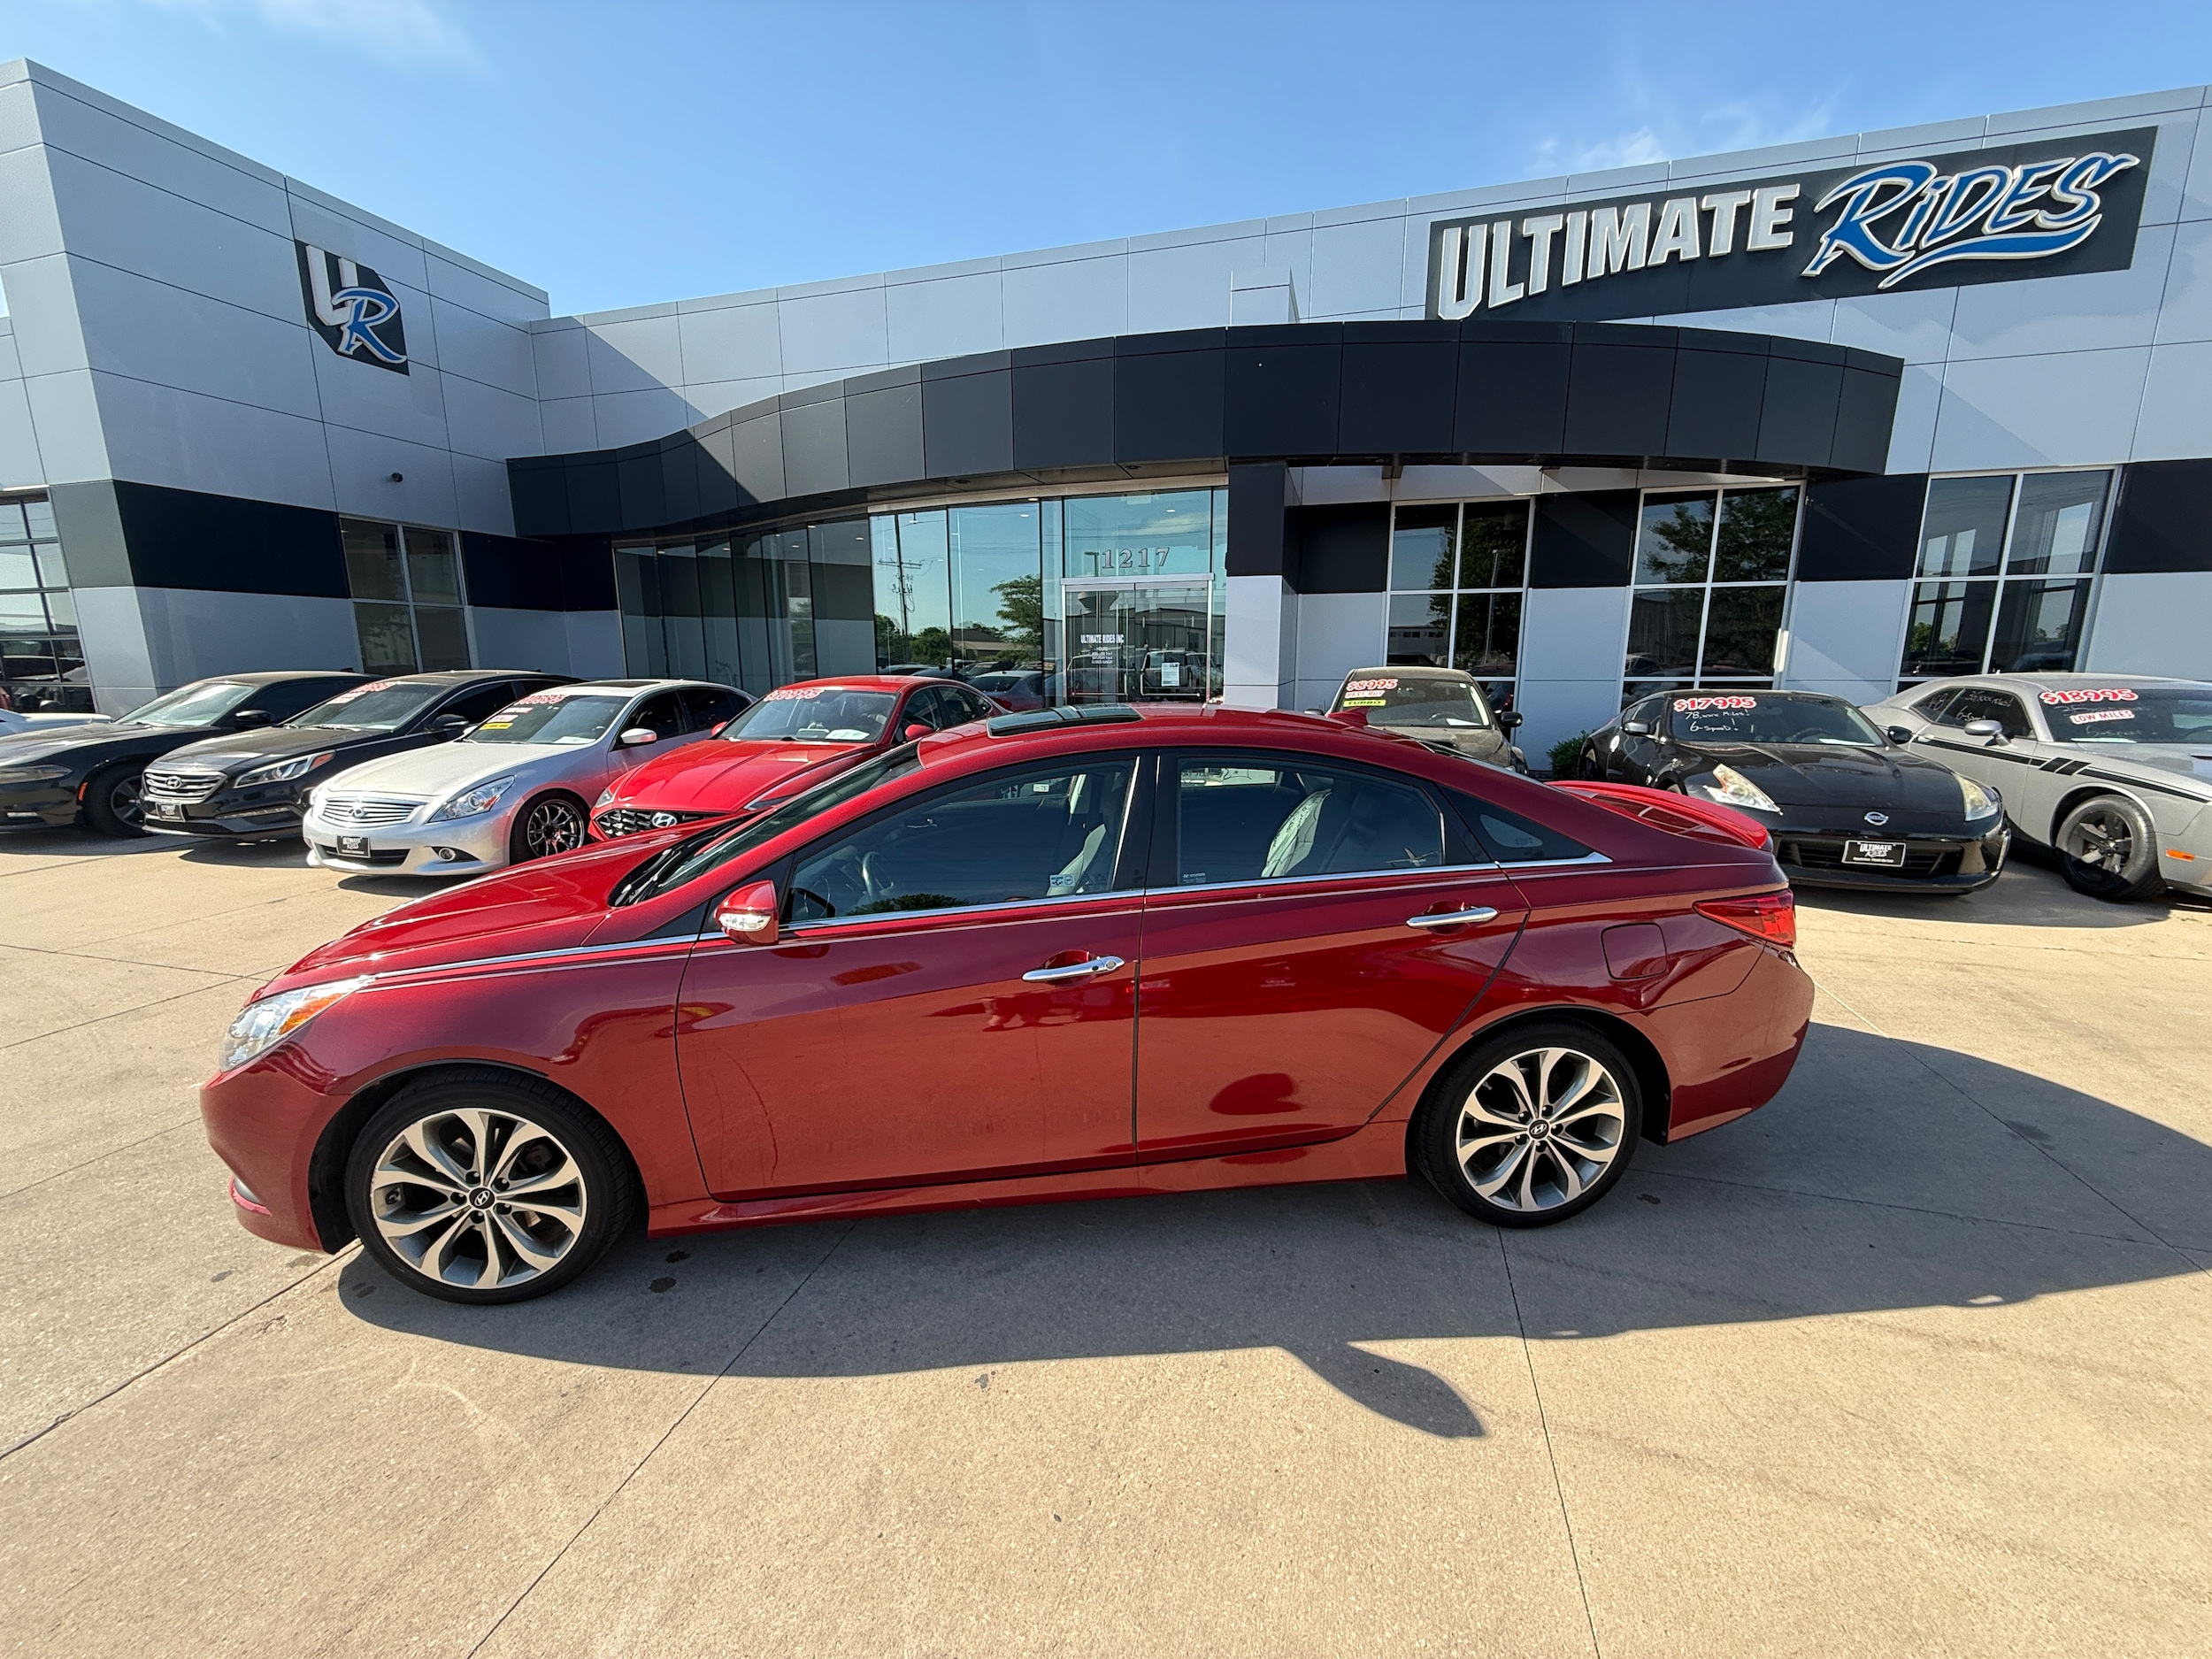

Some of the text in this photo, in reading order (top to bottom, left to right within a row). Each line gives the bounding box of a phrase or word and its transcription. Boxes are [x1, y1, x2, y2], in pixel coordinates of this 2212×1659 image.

[1438, 184, 1801, 320] ULTIMATE
[1102, 547, 1171, 569] 1217
[1674, 696, 1756, 711] $17995
[2039, 689, 2139, 704] $18995
[2073, 710, 2132, 723] LOW MILES
[1859, 843, 1893, 852] ULTIMATE
